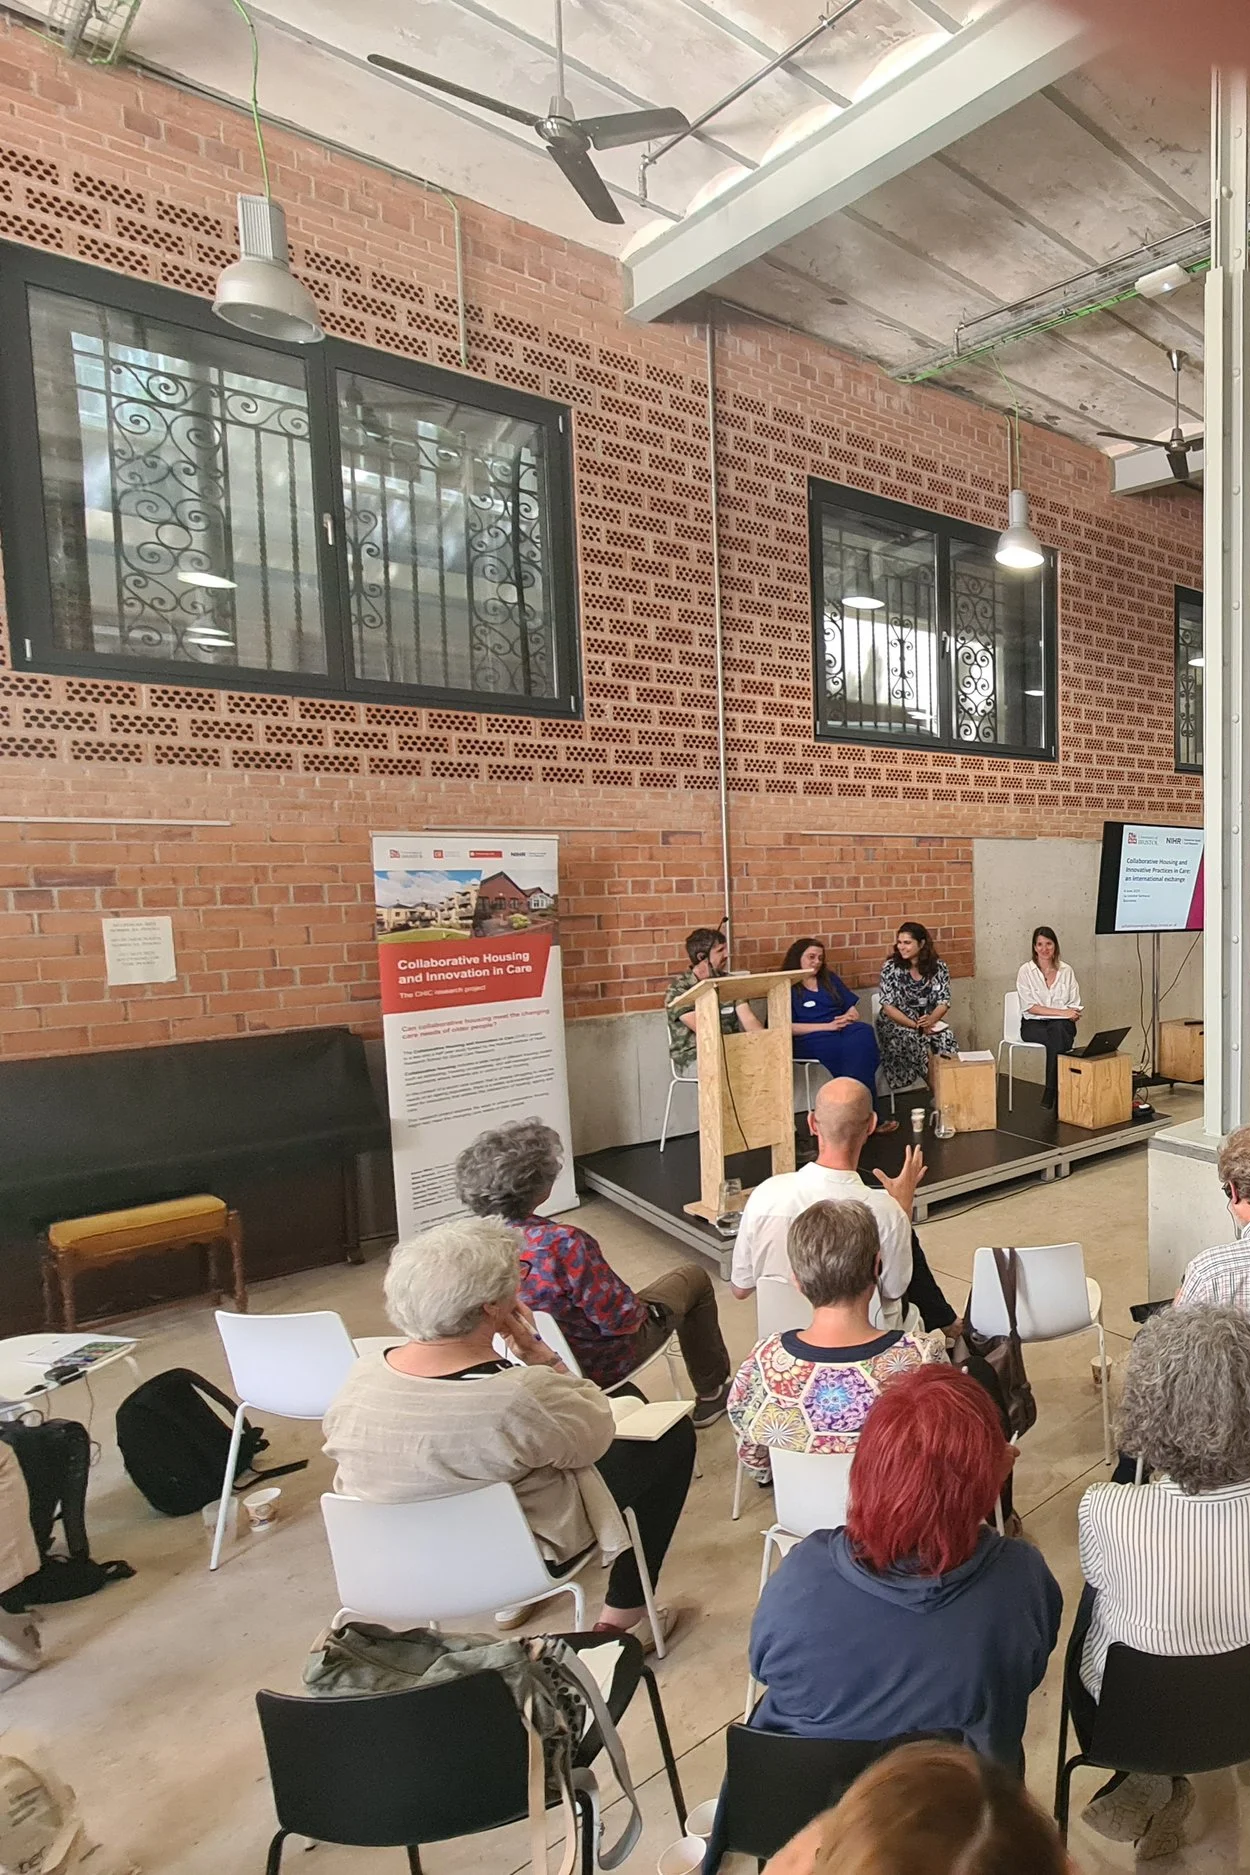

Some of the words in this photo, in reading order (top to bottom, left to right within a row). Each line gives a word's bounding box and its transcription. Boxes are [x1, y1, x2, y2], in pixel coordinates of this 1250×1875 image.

[1126, 857, 1158, 865] Collaborative
[1160, 858, 1178, 866] Housing
[397, 955, 480, 970] Collaborative
[483, 952, 530, 964] Housing
[398, 973, 423, 985] and
[426, 967, 490, 982] Innovation
[493, 966, 504, 976] in
[506, 964, 533, 975] Care
[434, 987, 464, 995] research
[464, 984, 487, 994] project
